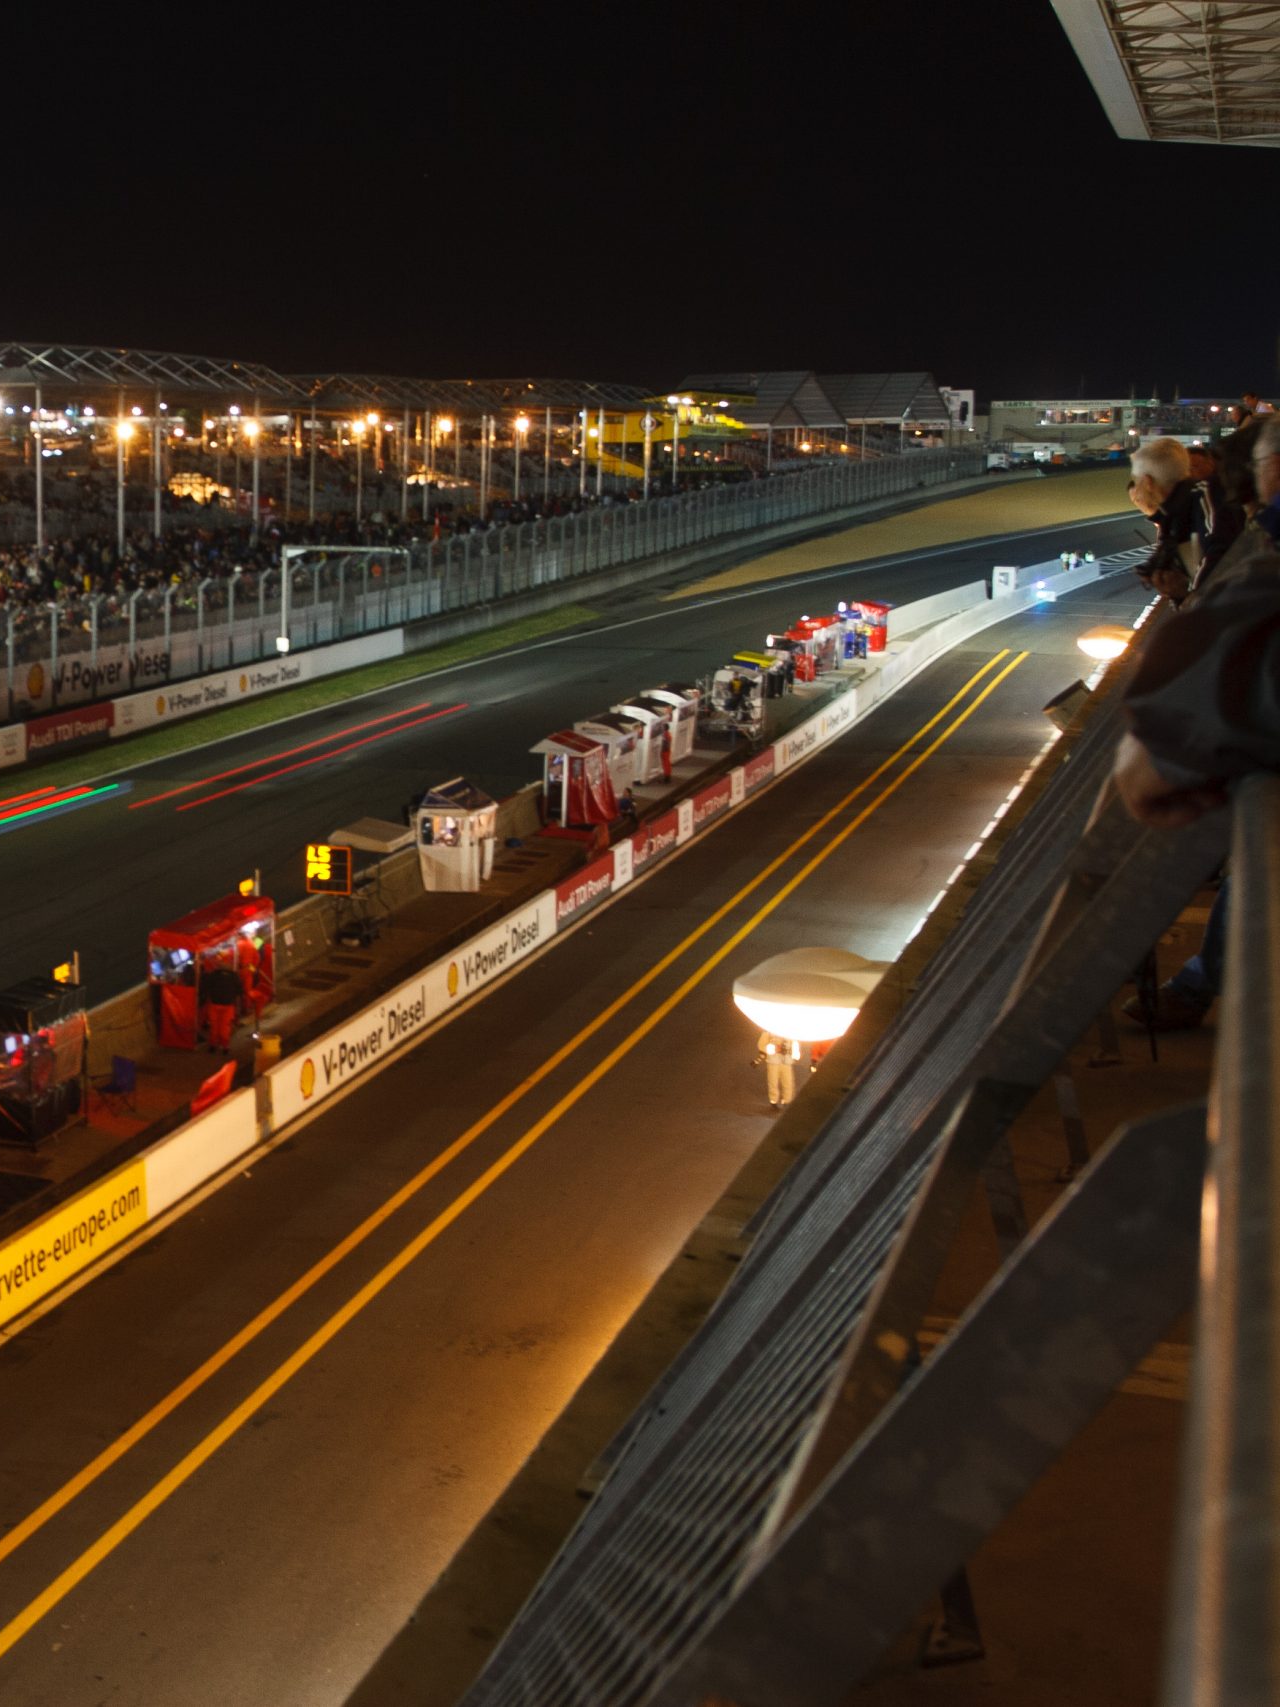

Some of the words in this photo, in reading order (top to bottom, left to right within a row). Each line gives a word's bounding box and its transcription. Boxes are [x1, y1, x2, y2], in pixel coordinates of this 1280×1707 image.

[28, 729, 55, 750] Audi
[56, 725, 74, 743] TDI
[75, 718, 108, 738] Power
[462, 941, 508, 987] V-Power
[511, 908, 539, 954] Diesel
[322, 1027, 383, 1085] V-Power
[388, 985, 426, 1041] Diesel
